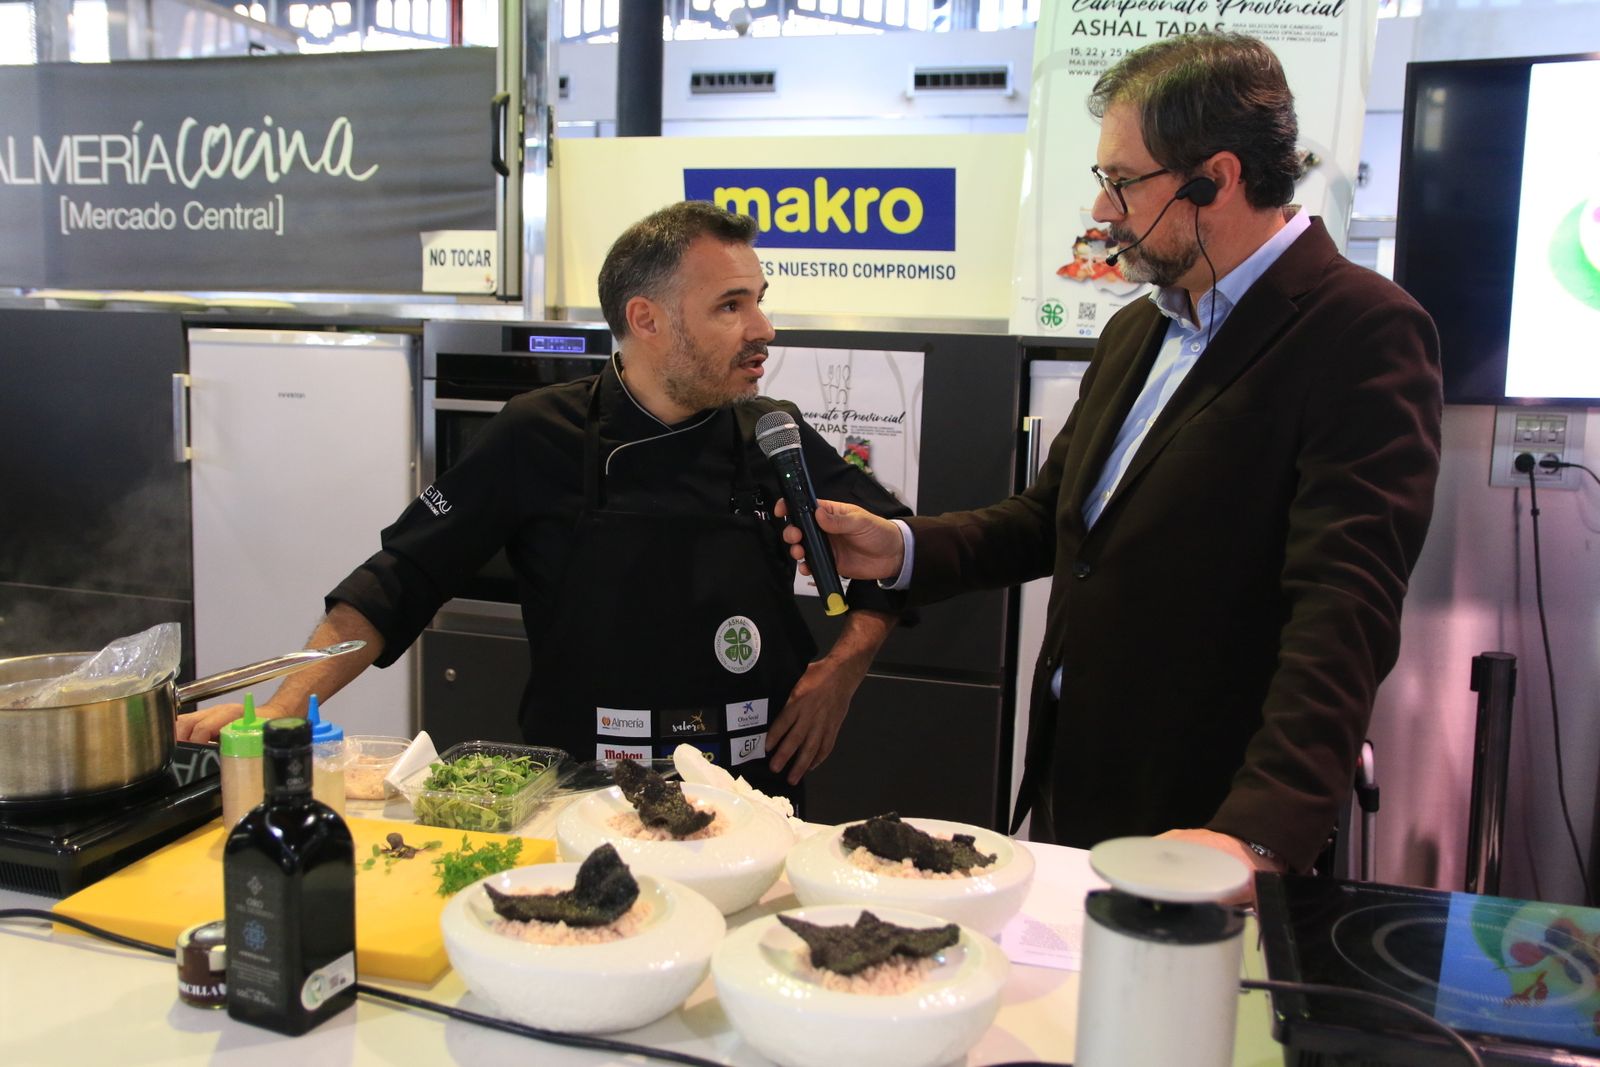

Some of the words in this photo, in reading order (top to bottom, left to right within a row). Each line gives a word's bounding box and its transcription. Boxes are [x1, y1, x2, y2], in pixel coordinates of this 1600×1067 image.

[1072, 19, 1147, 37] ASHAL
[1086, 48, 1098, 56] 22
[1110, 48, 1122, 57] 25
[714, 176, 924, 235] makro
[430, 249, 446, 267] NO
[451, 249, 491, 267] TOCAR
[779, 262, 848, 278] NUESTRO
[853, 263, 956, 281] COMPROMISO
[842, 409, 906, 424] Provincial
[813, 422, 848, 434] TAPAS
[604, 749, 643, 761] Mahou
